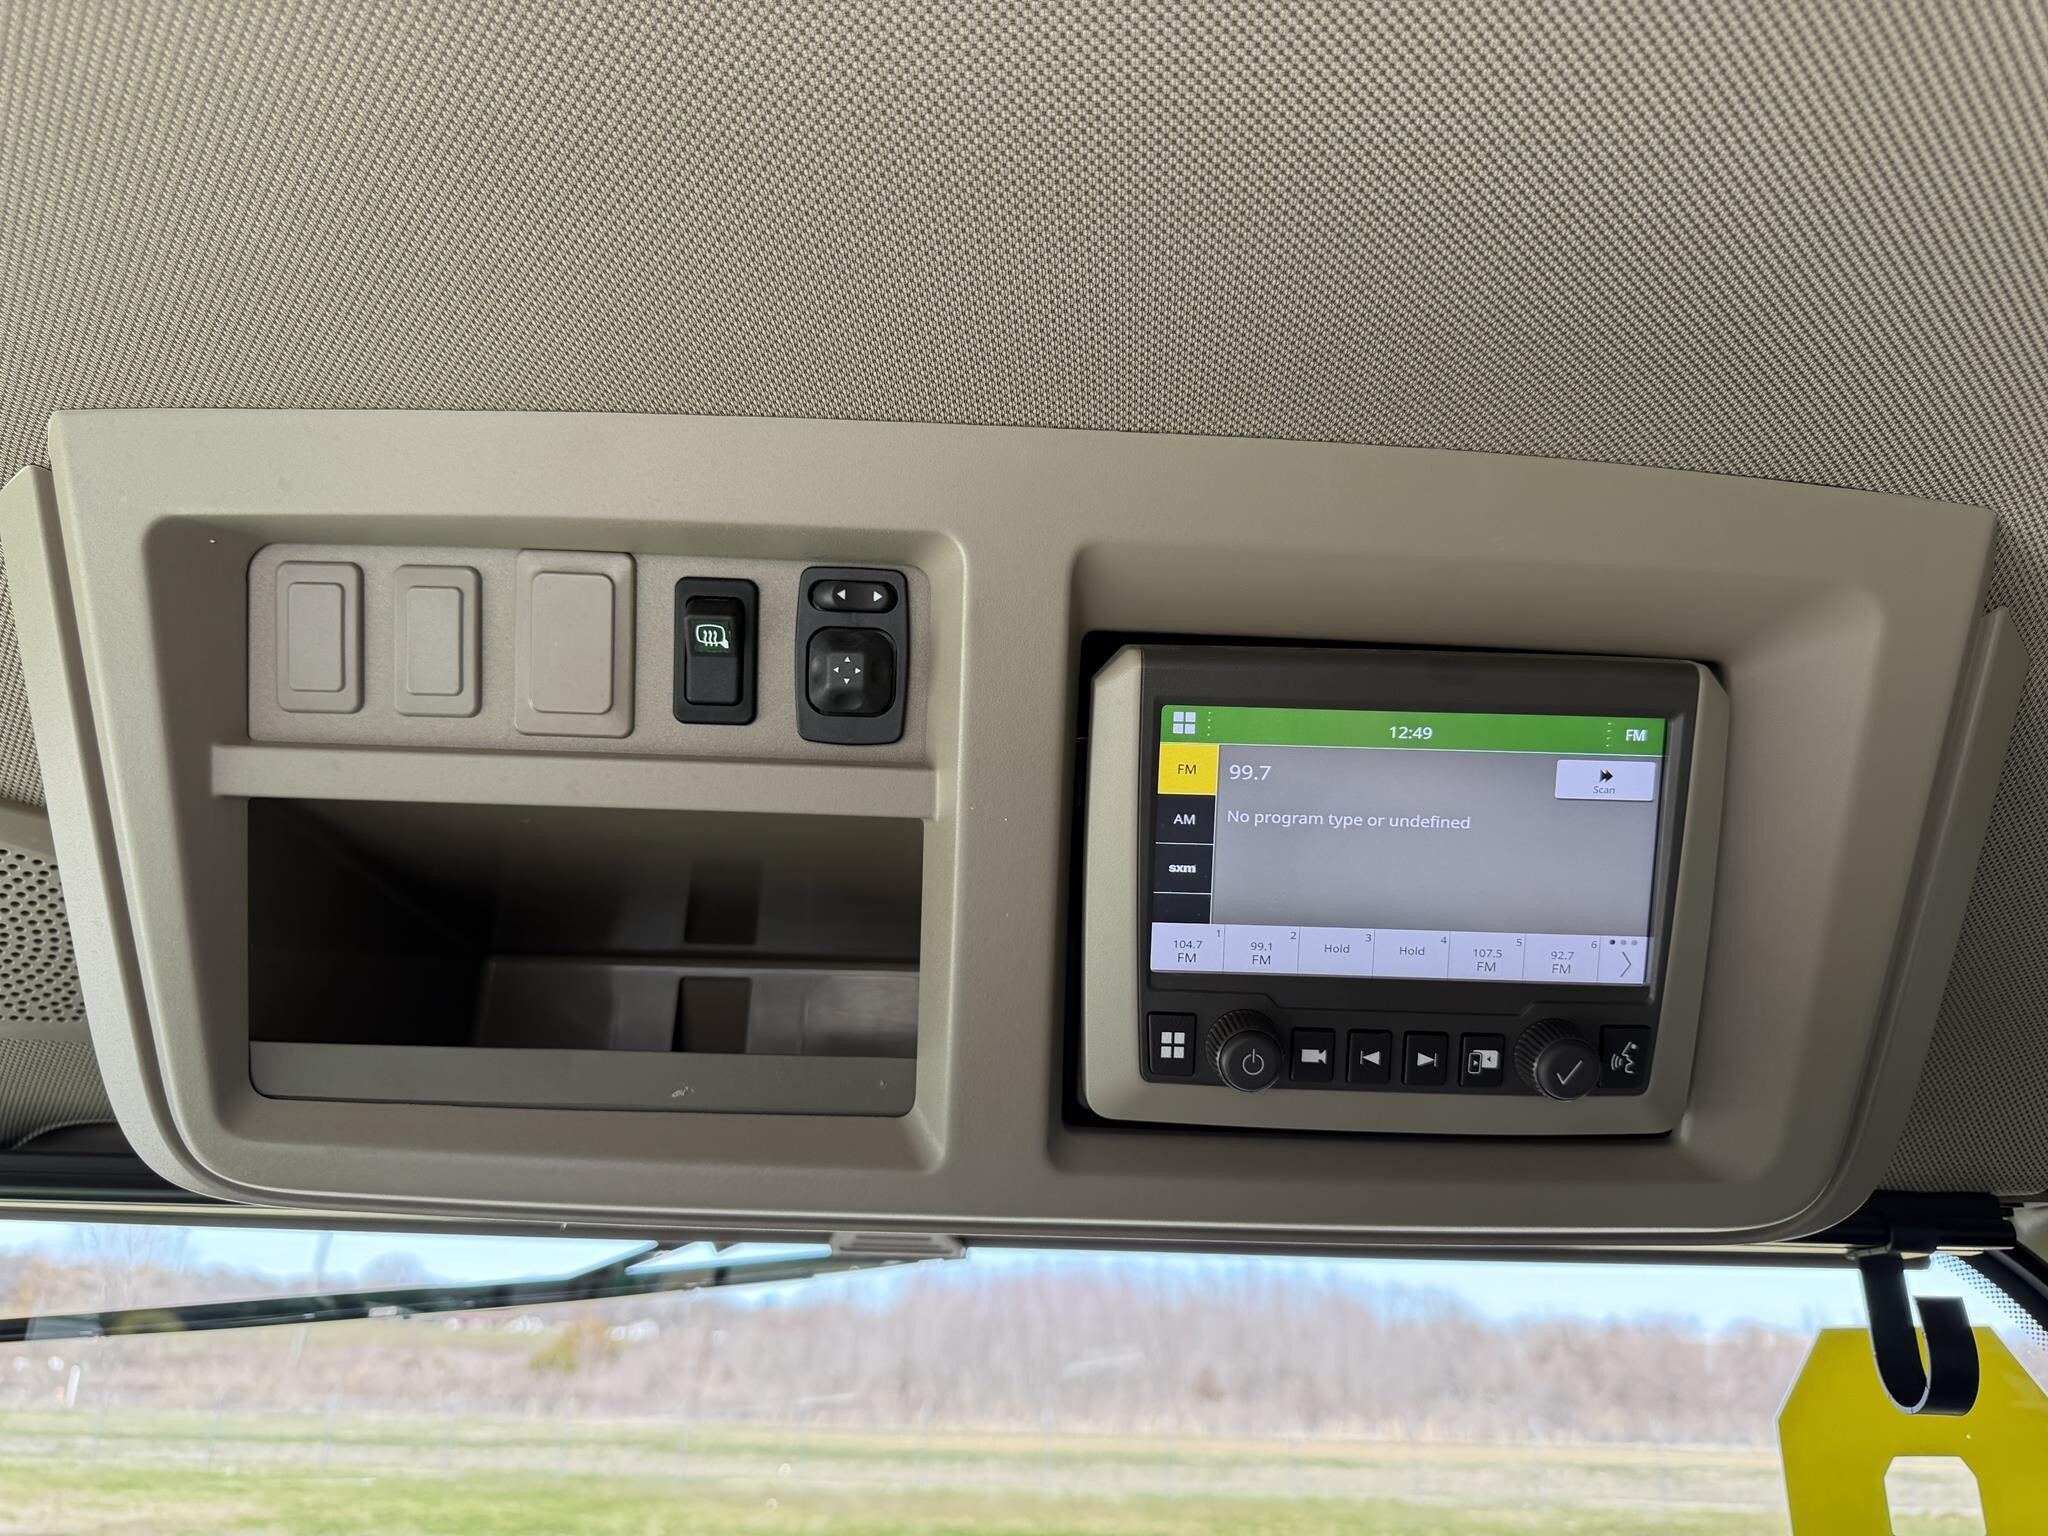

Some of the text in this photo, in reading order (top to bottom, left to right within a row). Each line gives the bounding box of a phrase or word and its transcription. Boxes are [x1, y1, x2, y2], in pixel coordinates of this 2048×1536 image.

[1389, 726, 1433, 740] 12:49
[1625, 729, 1648, 742] FM
[1177, 763, 1197, 775] FM
[1229, 764, 1272, 781] 99.7
[1593, 785, 1616, 795] Scan
[1173, 813, 1196, 825] AM
[1227, 810, 1471, 830] No program type or undefined
[1168, 863, 1197, 873] sxm
[1216, 929, 1222, 938] 1
[1290, 931, 1297, 940] 2
[1365, 933, 1372, 942] 3
[1173, 939, 1203, 949] 104.7
[1440, 936, 1447, 945] 4
[1515, 938, 1523, 947] 5
[1591, 940, 1598, 949] 6
[1250, 942, 1273, 951] 99.1
[1324, 943, 1350, 954] Hold
[1399, 945, 1425, 956] Hold
[1177, 952, 1197, 963] FM
[1473, 948, 1503, 958] 107.5
[1550, 950, 1575, 960] 92.7
[1251, 954, 1272, 966] FM
[1476, 961, 1496, 972] FM
[1551, 963, 1571, 975] FM
